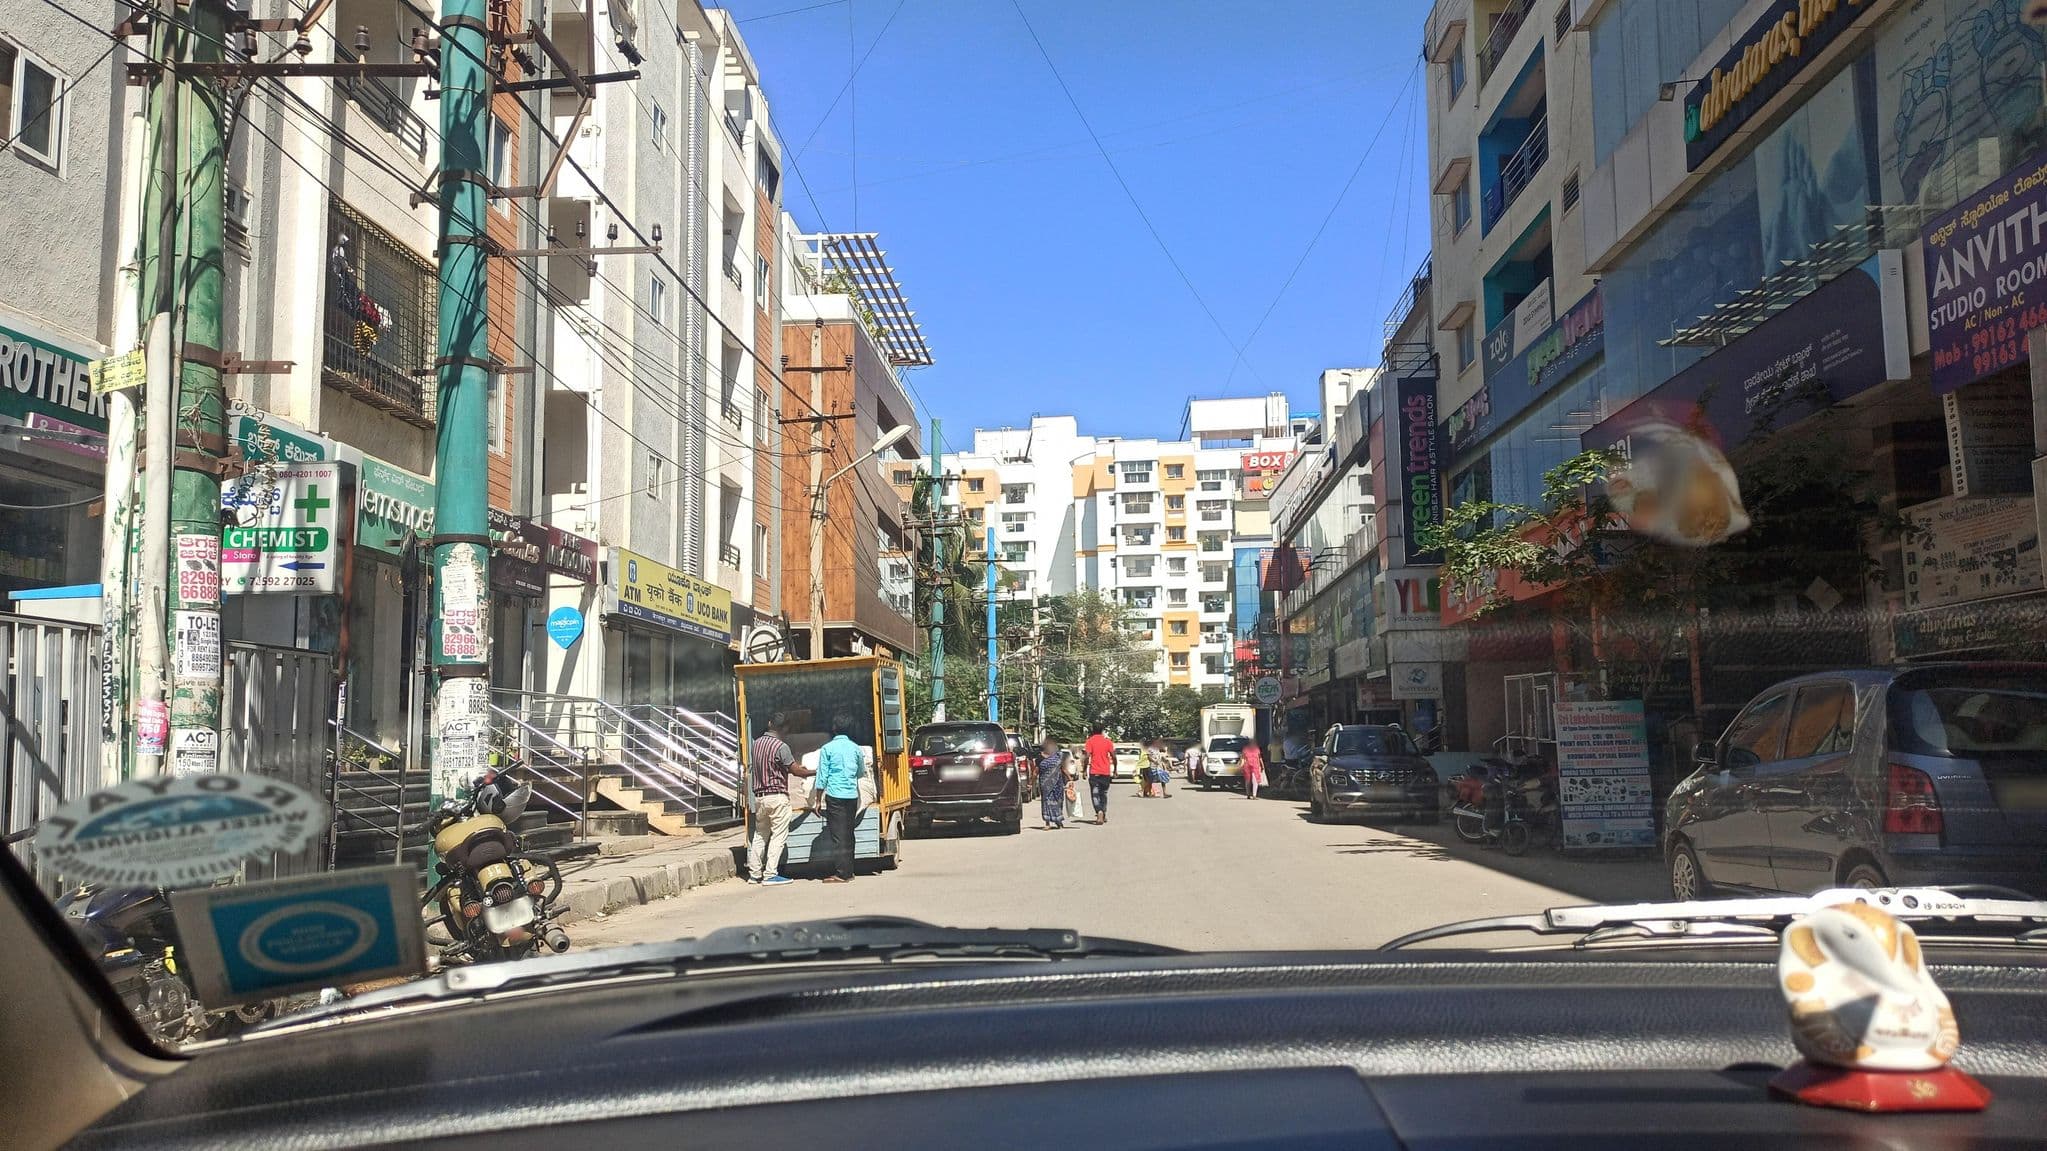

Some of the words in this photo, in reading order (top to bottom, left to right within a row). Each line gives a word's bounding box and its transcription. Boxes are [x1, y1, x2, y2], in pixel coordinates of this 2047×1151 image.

[1933, 201, 2047, 299] ANVITH
[1931, 285, 1986, 330] STUDIO
[1964, 314, 1976, 331] AC
[1984, 306, 2003, 324] Non
[2011, 291, 2025, 310] AC
[1971, 317, 2016, 354] 99162
[1972, 338, 2017, 375] 99163
[0, 334, 111, 420] ROTHER
[1427, 394, 1436, 427] SALON
[1402, 393, 1431, 473] trends
[1428, 428, 1437, 458] STYLE
[315, 470, 332, 478] 1007
[1410, 473, 1432, 546] green
[1430, 492, 1440, 530] NISEX
[229, 529, 319, 548] CHEMIST
[233, 550, 257, 560] Store
[180, 570, 218, 585] 82966
[284, 576, 315, 586] 27025
[180, 585, 218, 600] 66888
[624, 585, 642, 603] ATM
[646, 583, 665, 602] यूको
[667, 588, 684, 606] बैंक
[697, 601, 710, 617] UCO
[711, 605, 728, 624] BANK
[444, 633, 475, 644] 82966
[444, 644, 475, 655] 66888
[184, 731, 214, 744] ACT
[448, 722, 471, 731] ACT
